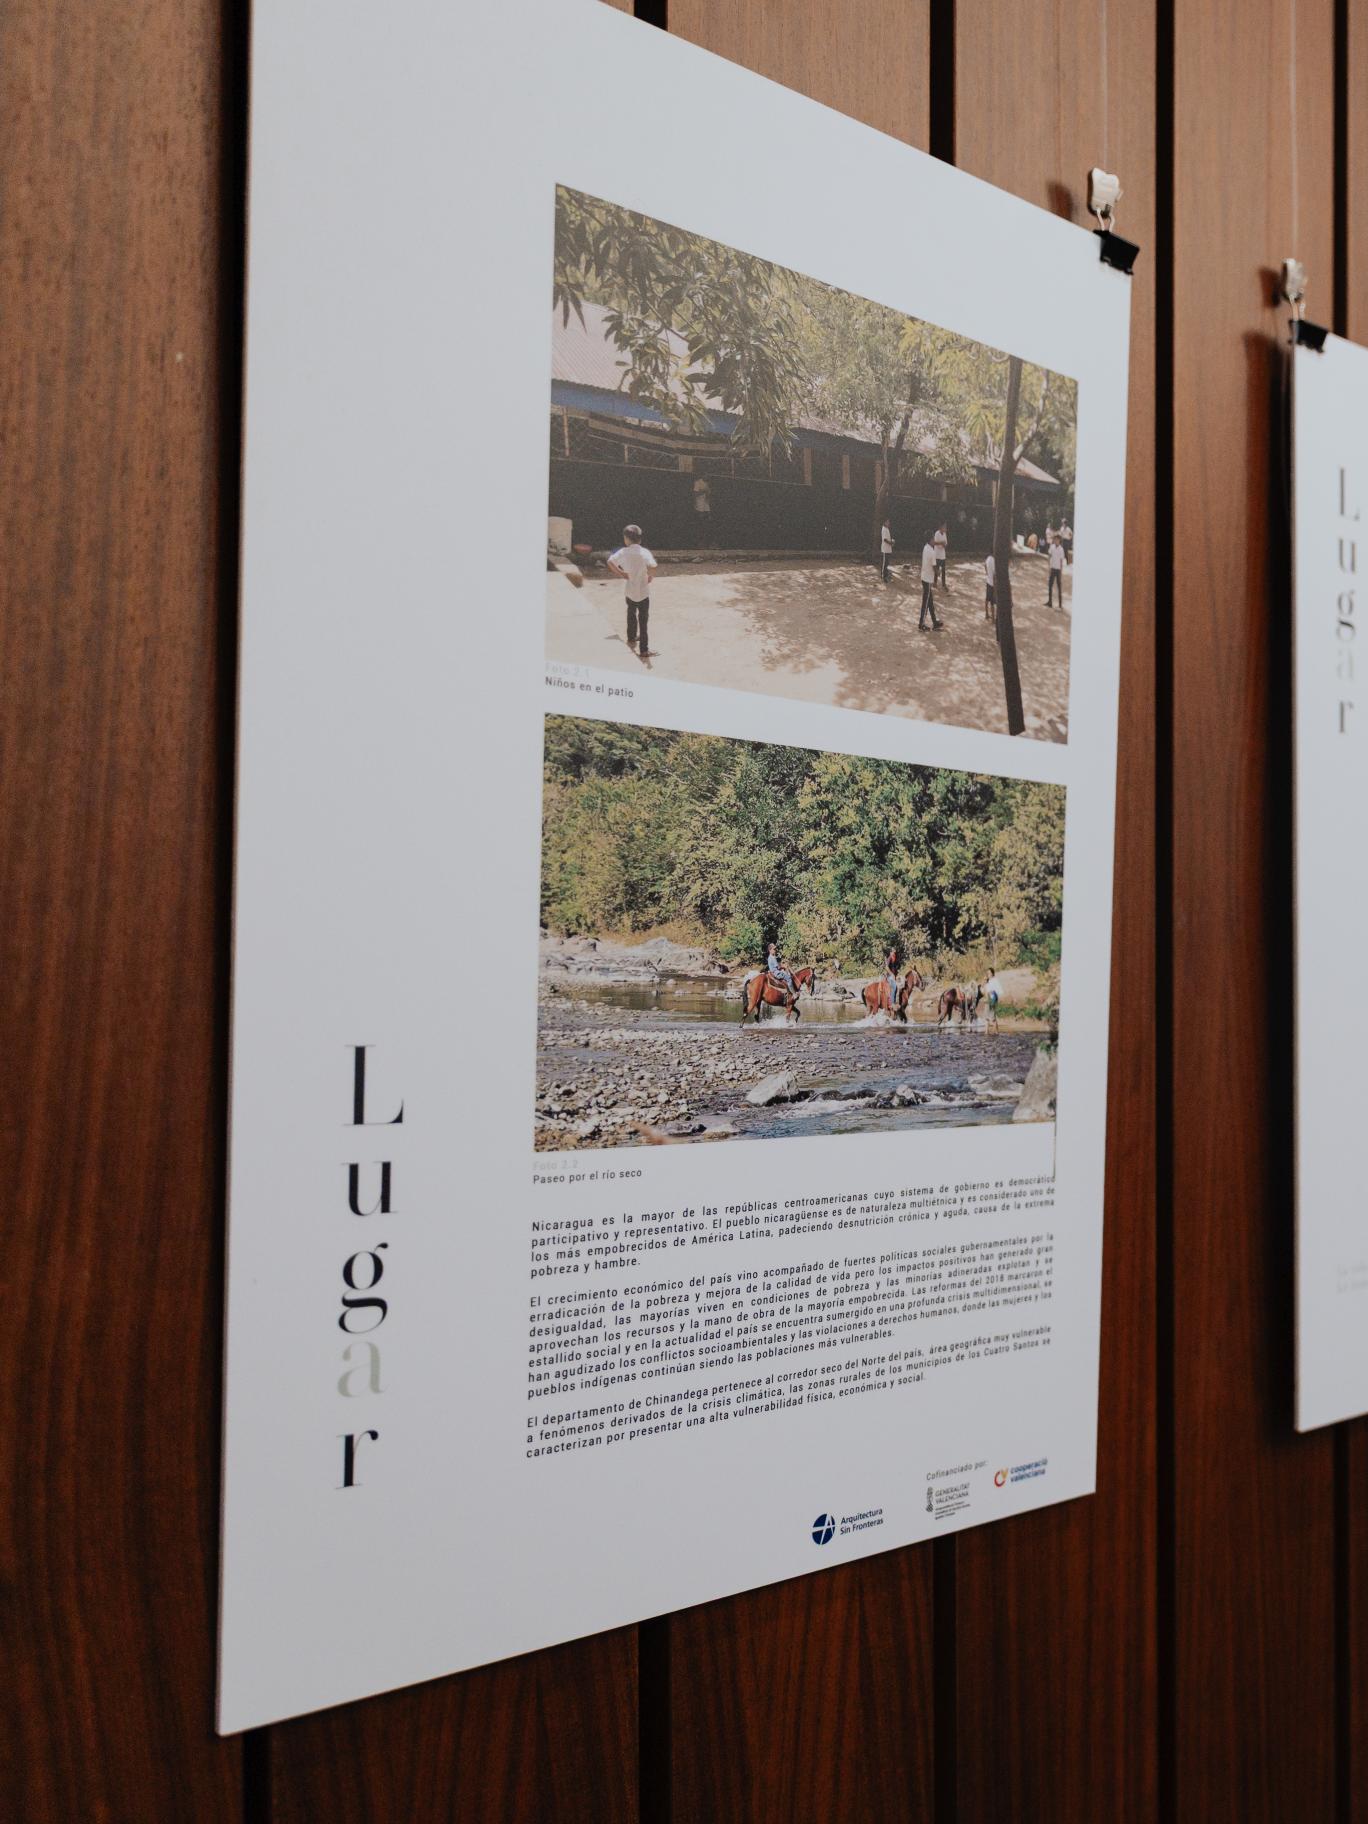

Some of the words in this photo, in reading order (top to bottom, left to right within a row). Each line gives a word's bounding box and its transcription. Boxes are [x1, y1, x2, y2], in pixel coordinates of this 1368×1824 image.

[544, 675, 576, 689] Niños
[579, 682, 592, 692] en
[595, 683, 605, 693] el
[607, 687, 634, 698] patio
[532, 1173, 565, 1184] Paseo
[569, 1173, 586, 1184] por
[589, 1171, 598, 1180] el
[602, 1169, 616, 1180] río
[619, 1169, 642, 1178] seco
[531, 1231, 609, 1250] participativo
[624, 1222, 708, 1239] representativo.
[712, 1217, 722, 1229] El
[725, 1214, 761, 1230] pueblo
[763, 1210, 829, 1224] nicaragüense
[831, 1208, 843, 1217] es
[845, 1205, 857, 1216] de
[532, 1218, 594, 1232] Nicaragua
[601, 1216, 615, 1226] es
[623, 1213, 633, 1224] la
[641, 1211, 675, 1223] mayor
[682, 1207, 695, 1218] de
[702, 1205, 718, 1217] las
[725, 1201, 778, 1216] repúblicas
[784, 1193, 868, 1209] centroamericanas
[531, 1251, 550, 1263] los
[556, 1249, 581, 1260] más
[587, 1238, 668, 1257] empobrecidos
[673, 1236, 686, 1247] de
[691, 1233, 734, 1245] América
[739, 1227, 774, 1240] Latina,
[778, 1220, 833, 1238] padeciendo
[837, 1216, 894, 1230] desnutrición
[334, 1044, 404, 1490] Lugar
[530, 1264, 579, 1280] pobreza
[594, 1256, 641, 1270] hambre.
[530, 1295, 541, 1308] El
[547, 1288, 618, 1306] crecimiento
[623, 1280, 684, 1296] económico
[689, 1275, 705, 1288] del
[710, 1272, 732, 1287] país
[737, 1271, 759, 1281] vino
[763, 1261, 824, 1278] acompañado
[828, 1259, 840, 1269] de
[844, 1256, 876, 1268] fuertes
[529, 1305, 606, 1323] erradicación
[611, 1300, 625, 1312] de
[630, 1298, 641, 1310] la
[646, 1294, 690, 1310] pobreza
[705, 1287, 741, 1300] mejora
[745, 1282, 758, 1294] de
[762, 1281, 772, 1292] la
[776, 1275, 812, 1290] calidad
[815, 1273, 828, 1284] de
[831, 1270, 851, 1282] vida
[854, 1269, 875, 1281] pero
[529, 1317, 606, 1338] desigualdad,
[614, 1315, 632, 1326] las
[639, 1306, 690, 1323] mayorías
[697, 1302, 725, 1314] viven
[731, 1300, 744, 1309] en
[750, 1291, 810, 1307] condiciones
[816, 1286, 828, 1297] de
[833, 1282, 870, 1297] pobreza
[528, 1334, 599, 1354] aprovechan
[604, 1330, 621, 1342] los
[626, 1324, 675, 1339] recursos
[690, 1318, 700, 1329] la
[704, 1315, 733, 1327] mano
[736, 1311, 749, 1322] de
[752, 1308, 775, 1320] obra
[779, 1305, 791, 1316] de
[794, 1303, 804, 1313] la
[807, 1299, 845, 1312] mayoría
[848, 1288, 908, 1306] empobrecida.
[528, 1350, 582, 1368] estallido
[586, 1343, 621, 1359] social
[634, 1342, 648, 1352] en
[651, 1338, 661, 1349] la
[664, 1328, 721, 1347] actualidad
[724, 1326, 734, 1338] el
[736, 1323, 758, 1338] país
[761, 1323, 773, 1332] se
[775, 1315, 824, 1330] encuentra
[825, 1306, 874, 1322] sumergido
[527, 1382, 576, 1401] pueblos
[580, 1372, 637, 1390] indígenas
[641, 1362, 696, 1379] continúan
[699, 1354, 734, 1370] siendo
[737, 1352, 753, 1363] las
[756, 1342, 815, 1362] poblaciones
[818, 1337, 837, 1349] más
[840, 1328, 895, 1345] vulnerables.
[528, 1371, 550, 1383] han
[554, 1360, 616, 1380] agudizado
[619, 1357, 636, 1369] los
[639, 1349, 695, 1365] conflictos
[698, 1333, 788, 1356] socioambientales
[798, 1329, 813, 1339] las
[815, 1320, 868, 1336] violaciones
[527, 1415, 538, 1428] El
[542, 1403, 625, 1426] departamento
[628, 1398, 642, 1410] de
[645, 1388, 709, 1407] Chinandega
[711, 1378, 763, 1397] pertenece
[765, 1373, 774, 1385] al
[777, 1367, 818, 1383] corredor
[820, 1364, 843, 1375] seco
[844, 1358, 859, 1370] del
[861, 1356, 886, 1367] Norte
[539, 1421, 605, 1441] fenómenos
[610, 1409, 666, 1428] derivados
[670, 1405, 683, 1416] de
[687, 1402, 698, 1413] la
[702, 1397, 732, 1411] crisis
[735, 1388, 785, 1404] climática,
[789, 1383, 804, 1394] las
[807, 1378, 836, 1391] zonas
[839, 1370, 871, 1384] rurales
[875, 1367, 886, 1377] de
[526, 1436, 602, 1459] caracterizan
[606, 1431, 625, 1445] por
[629, 1420, 683, 1441] presentar
[686, 1416, 706, 1427] una
[709, 1411, 729, 1423] alta
[732, 1394, 804, 1418] vulnerabilidad
[806, 1391, 836, 1403] física,
[838, 1381, 887, 1397] económica
[926, 1462, 973, 1481] Cofinanciado
[935, 1482, 970, 1497] GENERALITAT
[1010, 1468, 1046, 1483] valenciana
[840, 1507, 883, 1526] Arquitectura
[935, 1490, 969, 1505] VALENCIANA
[840, 1522, 851, 1536] Sin
[852, 1518, 884, 1532] Fronteras
